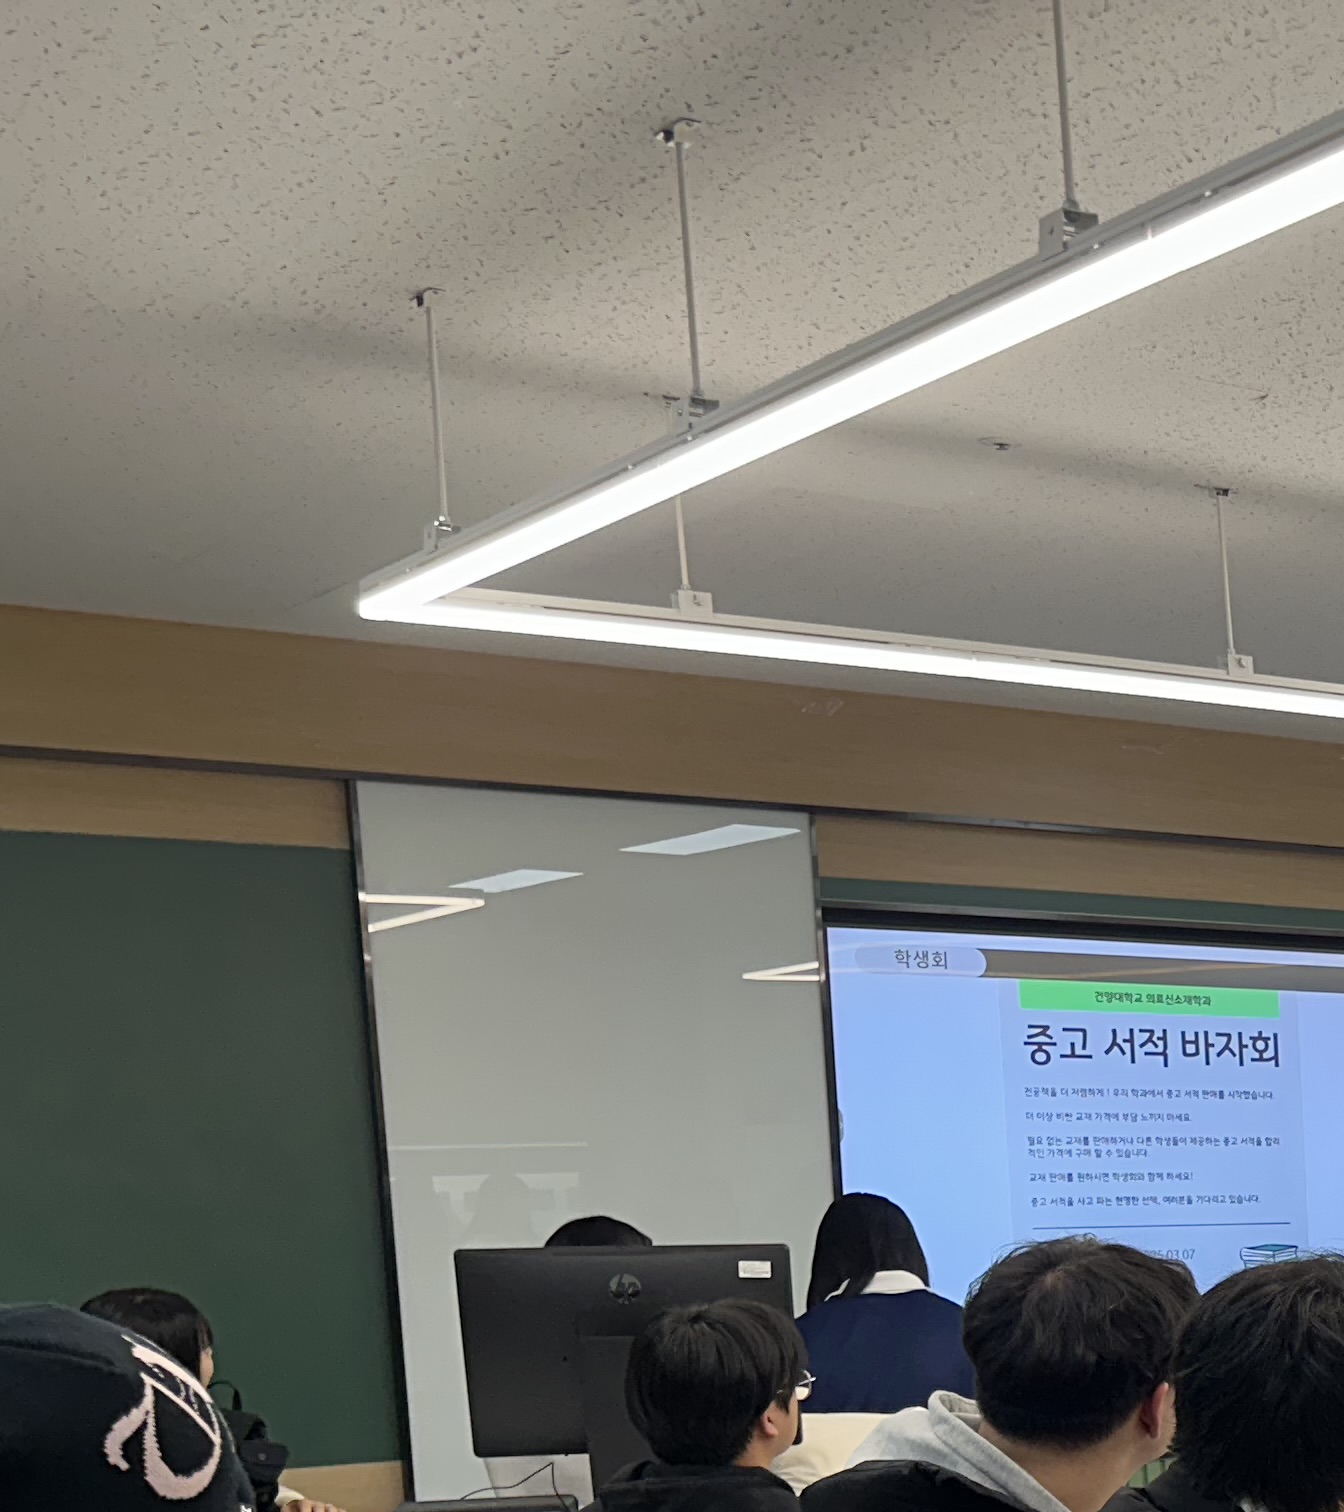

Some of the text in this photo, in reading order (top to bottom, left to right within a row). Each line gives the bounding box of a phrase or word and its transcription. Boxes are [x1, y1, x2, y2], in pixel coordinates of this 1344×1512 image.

[894, 949, 948, 969] 학생회
[1094, 991, 1211, 1007] 건양대학교 의료신소재학과
[1023, 1024, 1280, 1068] 중고 서적 바자회
[1060, 1087, 1069, 1098] 더
[1025, 1112, 1034, 1122] 더
[1105, 1148, 1113, 1158] 수
[1144, 1248, 1195, 1260] 25.03.07
